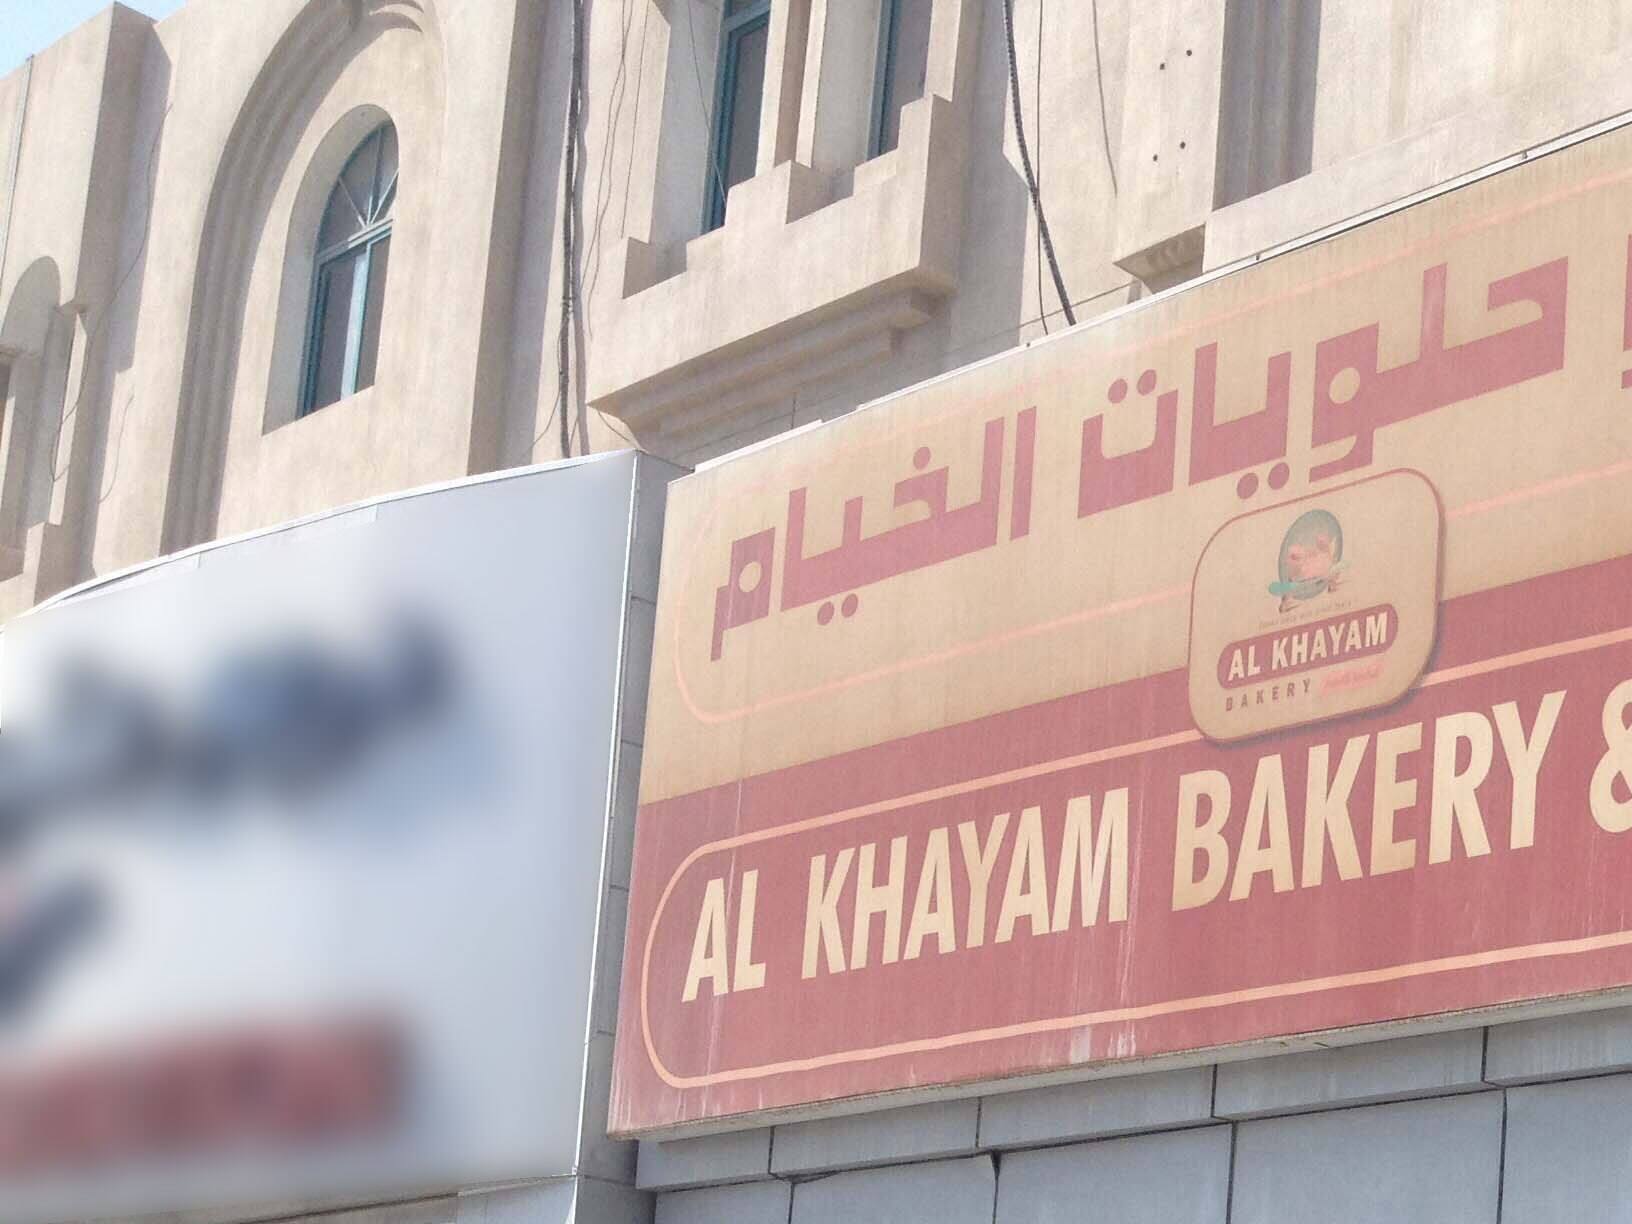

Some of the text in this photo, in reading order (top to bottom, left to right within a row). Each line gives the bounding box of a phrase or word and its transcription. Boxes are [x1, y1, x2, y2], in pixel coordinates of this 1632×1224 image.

[1078, 255, 1569, 518] حلويات
[711, 405, 1036, 662] الخيام
[1228, 645, 1261, 681] AL
[1272, 612, 1388, 669] KHAYAM
[1226, 678, 1311, 711] BAKERY
[682, 869, 766, 1003] AL
[801, 786, 1129, 980] KHAYAM
[1172, 689, 1566, 911] BAKERY
